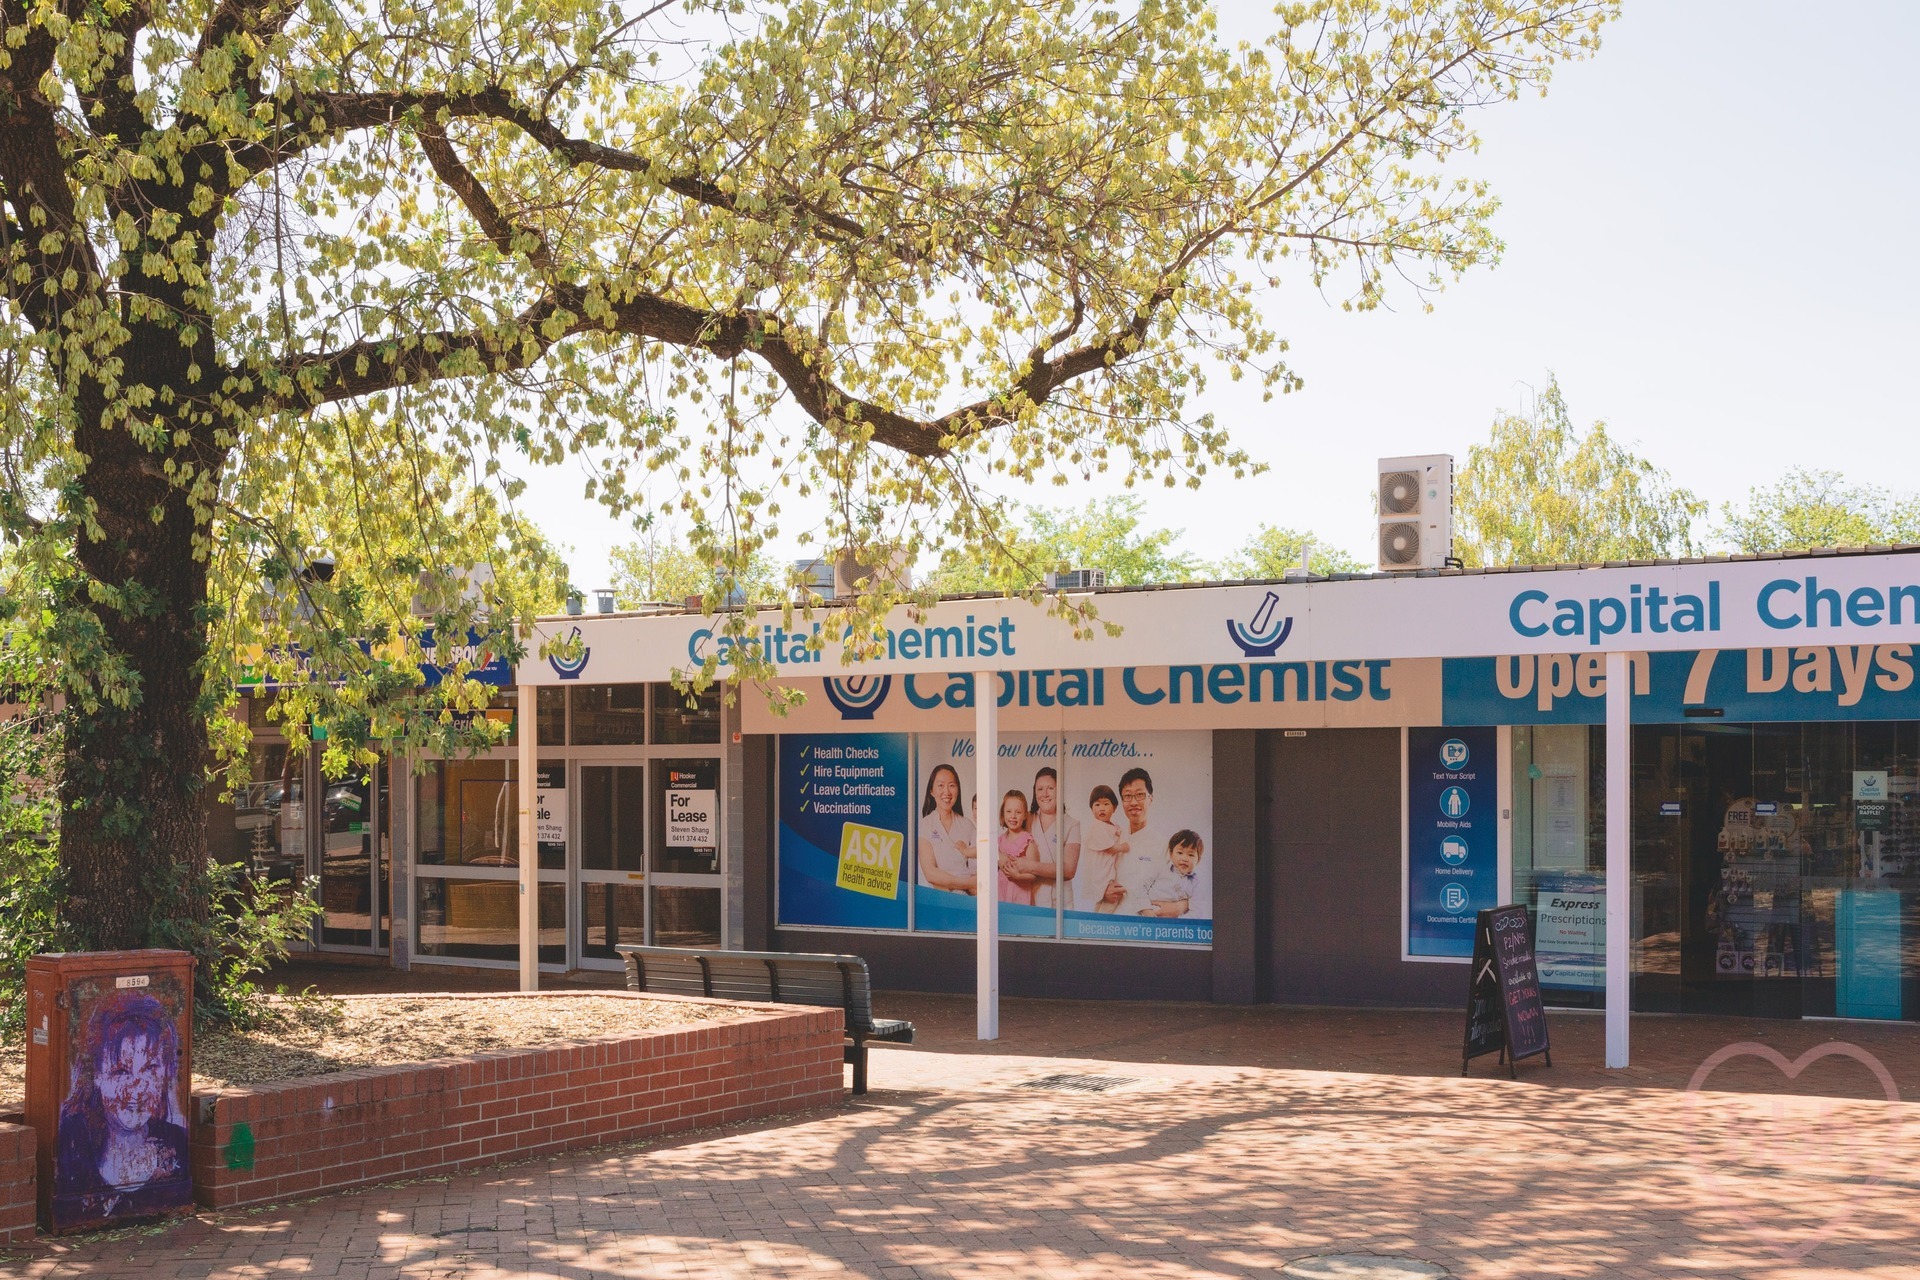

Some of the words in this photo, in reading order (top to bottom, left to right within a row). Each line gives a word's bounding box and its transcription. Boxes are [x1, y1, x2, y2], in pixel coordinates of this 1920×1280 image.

[1509, 581, 1720, 645] Capital
[1683, 649, 1719, 704] 7
[1747, 643, 1914, 706] Days
[1123, 660, 1391, 705] Chemist
[814, 747, 843, 759] Health
[846, 747, 879, 759] Checks
[952, 738, 975, 757] We
[997, 744, 1021, 757] ow
[814, 766, 832, 777] Hire
[835, 765, 884, 779] Equipment
[1459, 773, 1476, 781] Script
[814, 784, 840, 796] Leave
[843, 783, 896, 796] Certificates
[670, 794, 690, 807] For
[537, 808, 551, 820] ale
[814, 802, 871, 814] Vaccinations
[670, 809, 707, 822] Lease
[1728, 811, 1749, 821] FREE
[691, 827, 709, 835] Shang
[1437, 821, 1458, 829] Mobility
[845, 829, 896, 869] ASK
[853, 863, 884, 877] pharmacist
[885, 870, 893, 880] for
[1452, 868, 1473, 876] Delivery
[842, 871, 865, 886] health
[867, 876, 892, 891] advice
[1551, 898, 1600, 911] Express
[1427, 915, 1458, 923] Documents
[1541, 914, 1606, 926] Prescriptions
[1079, 922, 1120, 935] because
[1123, 924, 1152, 937] we're
[1155, 927, 1194, 940] parents
[1197, 928, 1213, 940] too
[1554, 970, 1575, 978] Capital
[1509, 989, 1520, 1005] GET
